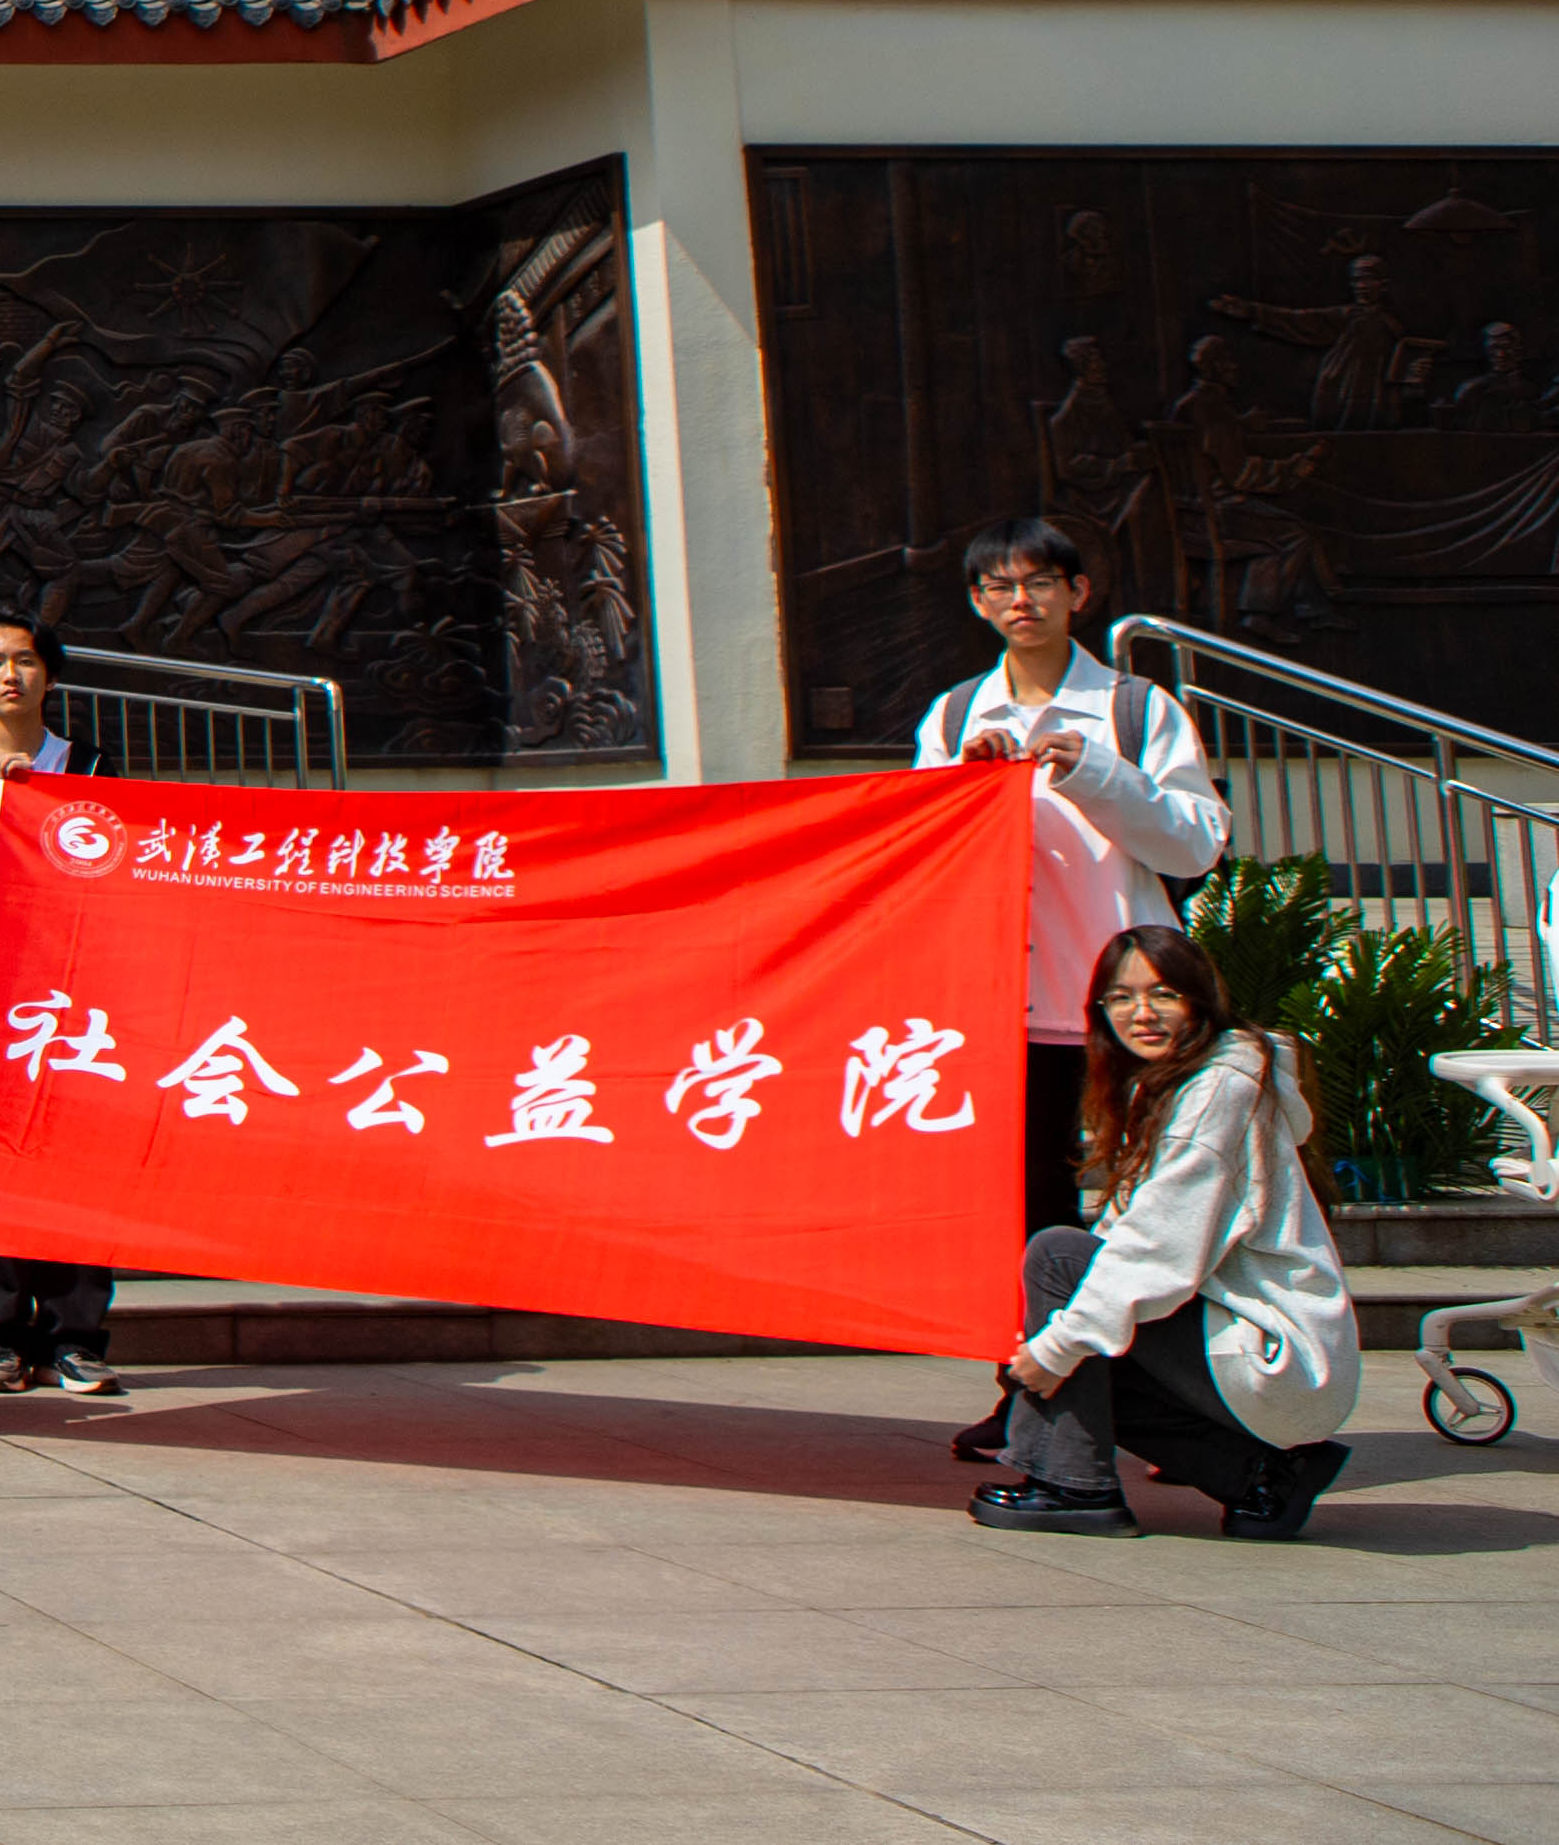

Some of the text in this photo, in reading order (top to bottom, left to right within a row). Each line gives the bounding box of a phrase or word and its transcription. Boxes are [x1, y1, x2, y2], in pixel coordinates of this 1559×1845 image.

[132, 868, 515, 898] WUHAN UNIVERSITY OF ENGINEERING SCIENCE
[7, 990, 975, 1150] 社会公益学院
